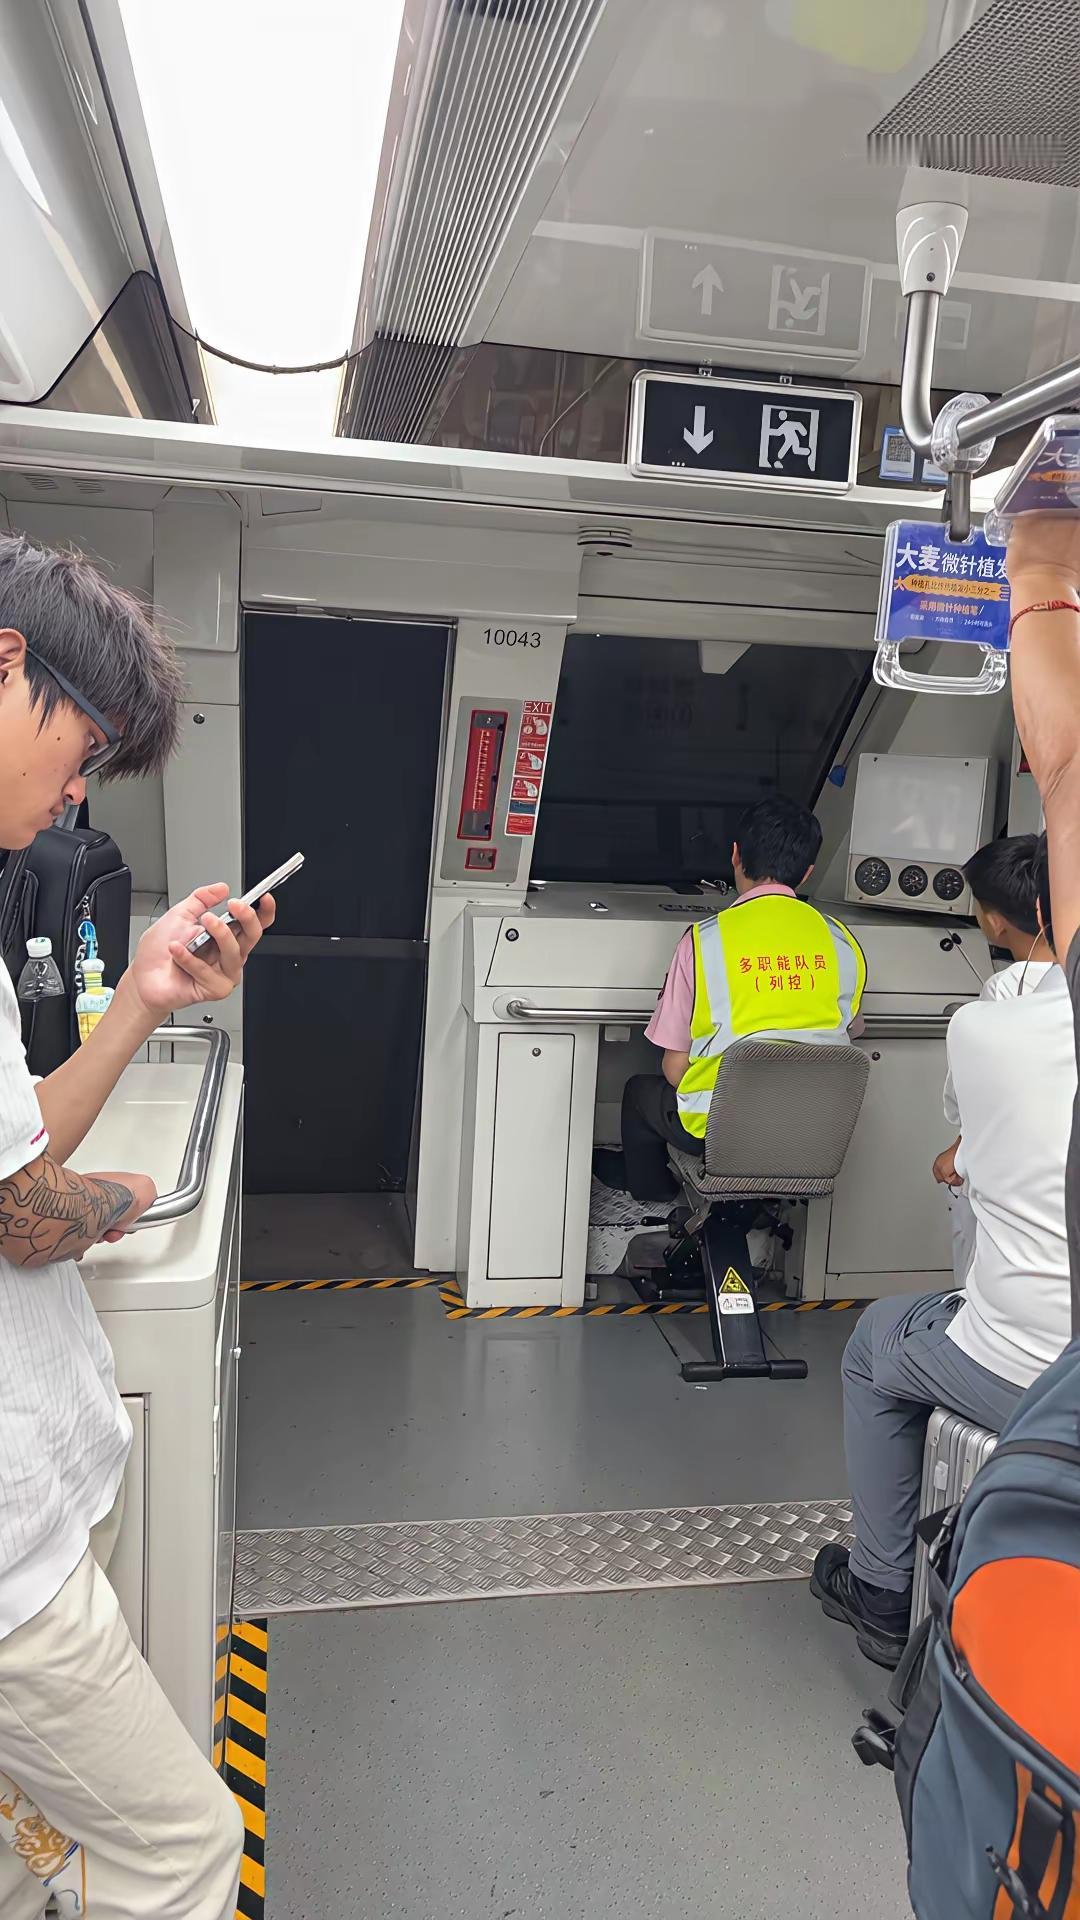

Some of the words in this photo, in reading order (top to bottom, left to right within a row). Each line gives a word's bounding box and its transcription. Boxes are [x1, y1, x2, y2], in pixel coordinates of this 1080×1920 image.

[484, 628, 541, 648] 10043
[523, 701, 552, 713] EXIT
[740, 954, 827, 974] 多职能队员
